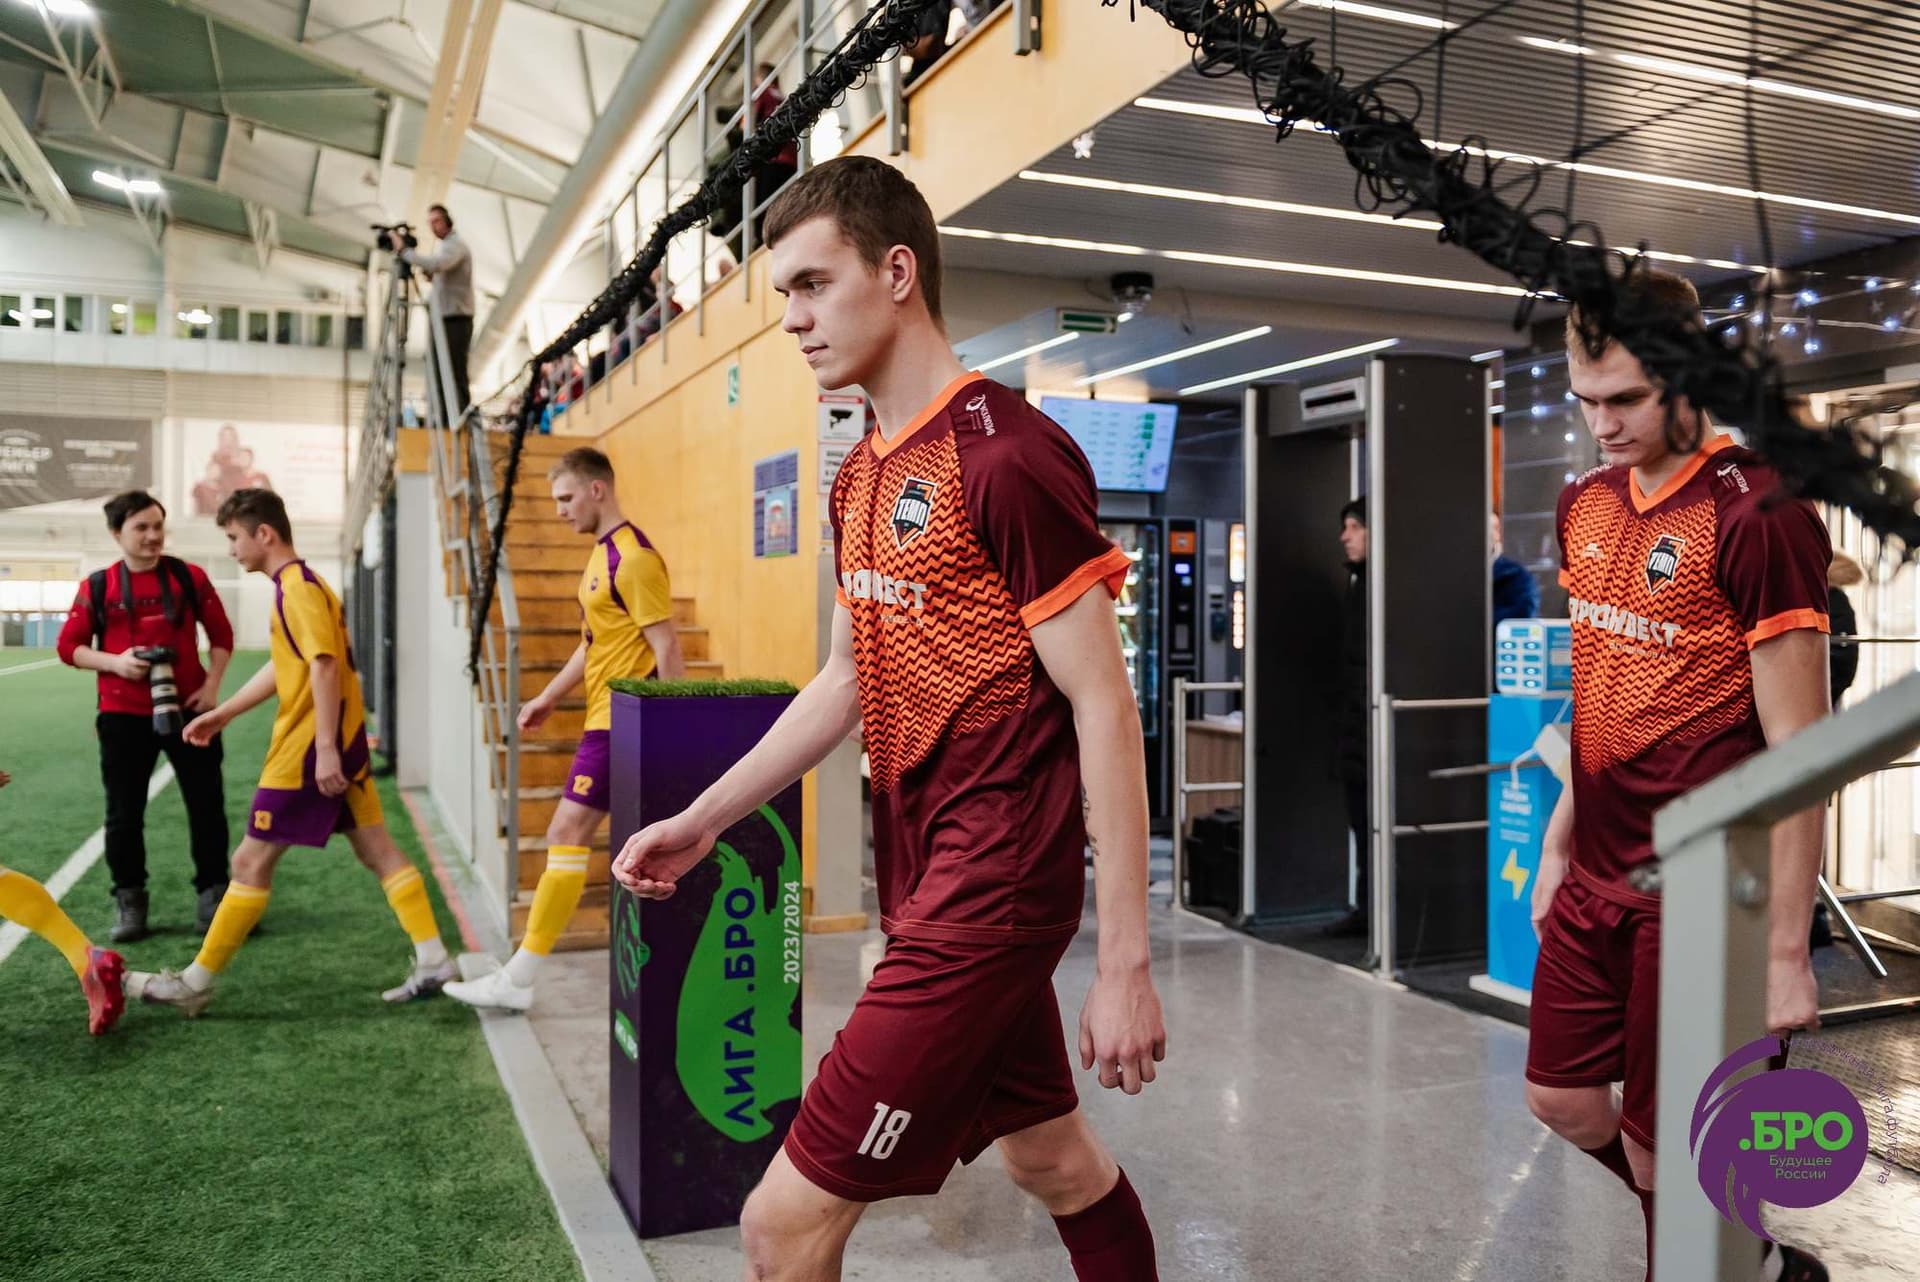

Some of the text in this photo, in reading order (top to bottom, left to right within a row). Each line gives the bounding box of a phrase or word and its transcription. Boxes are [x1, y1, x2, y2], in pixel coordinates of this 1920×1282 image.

[783, 880, 800, 984] 2023/2024
[724, 1006, 756, 1127] ЛИГА
[857, 1101, 912, 1160] 18
